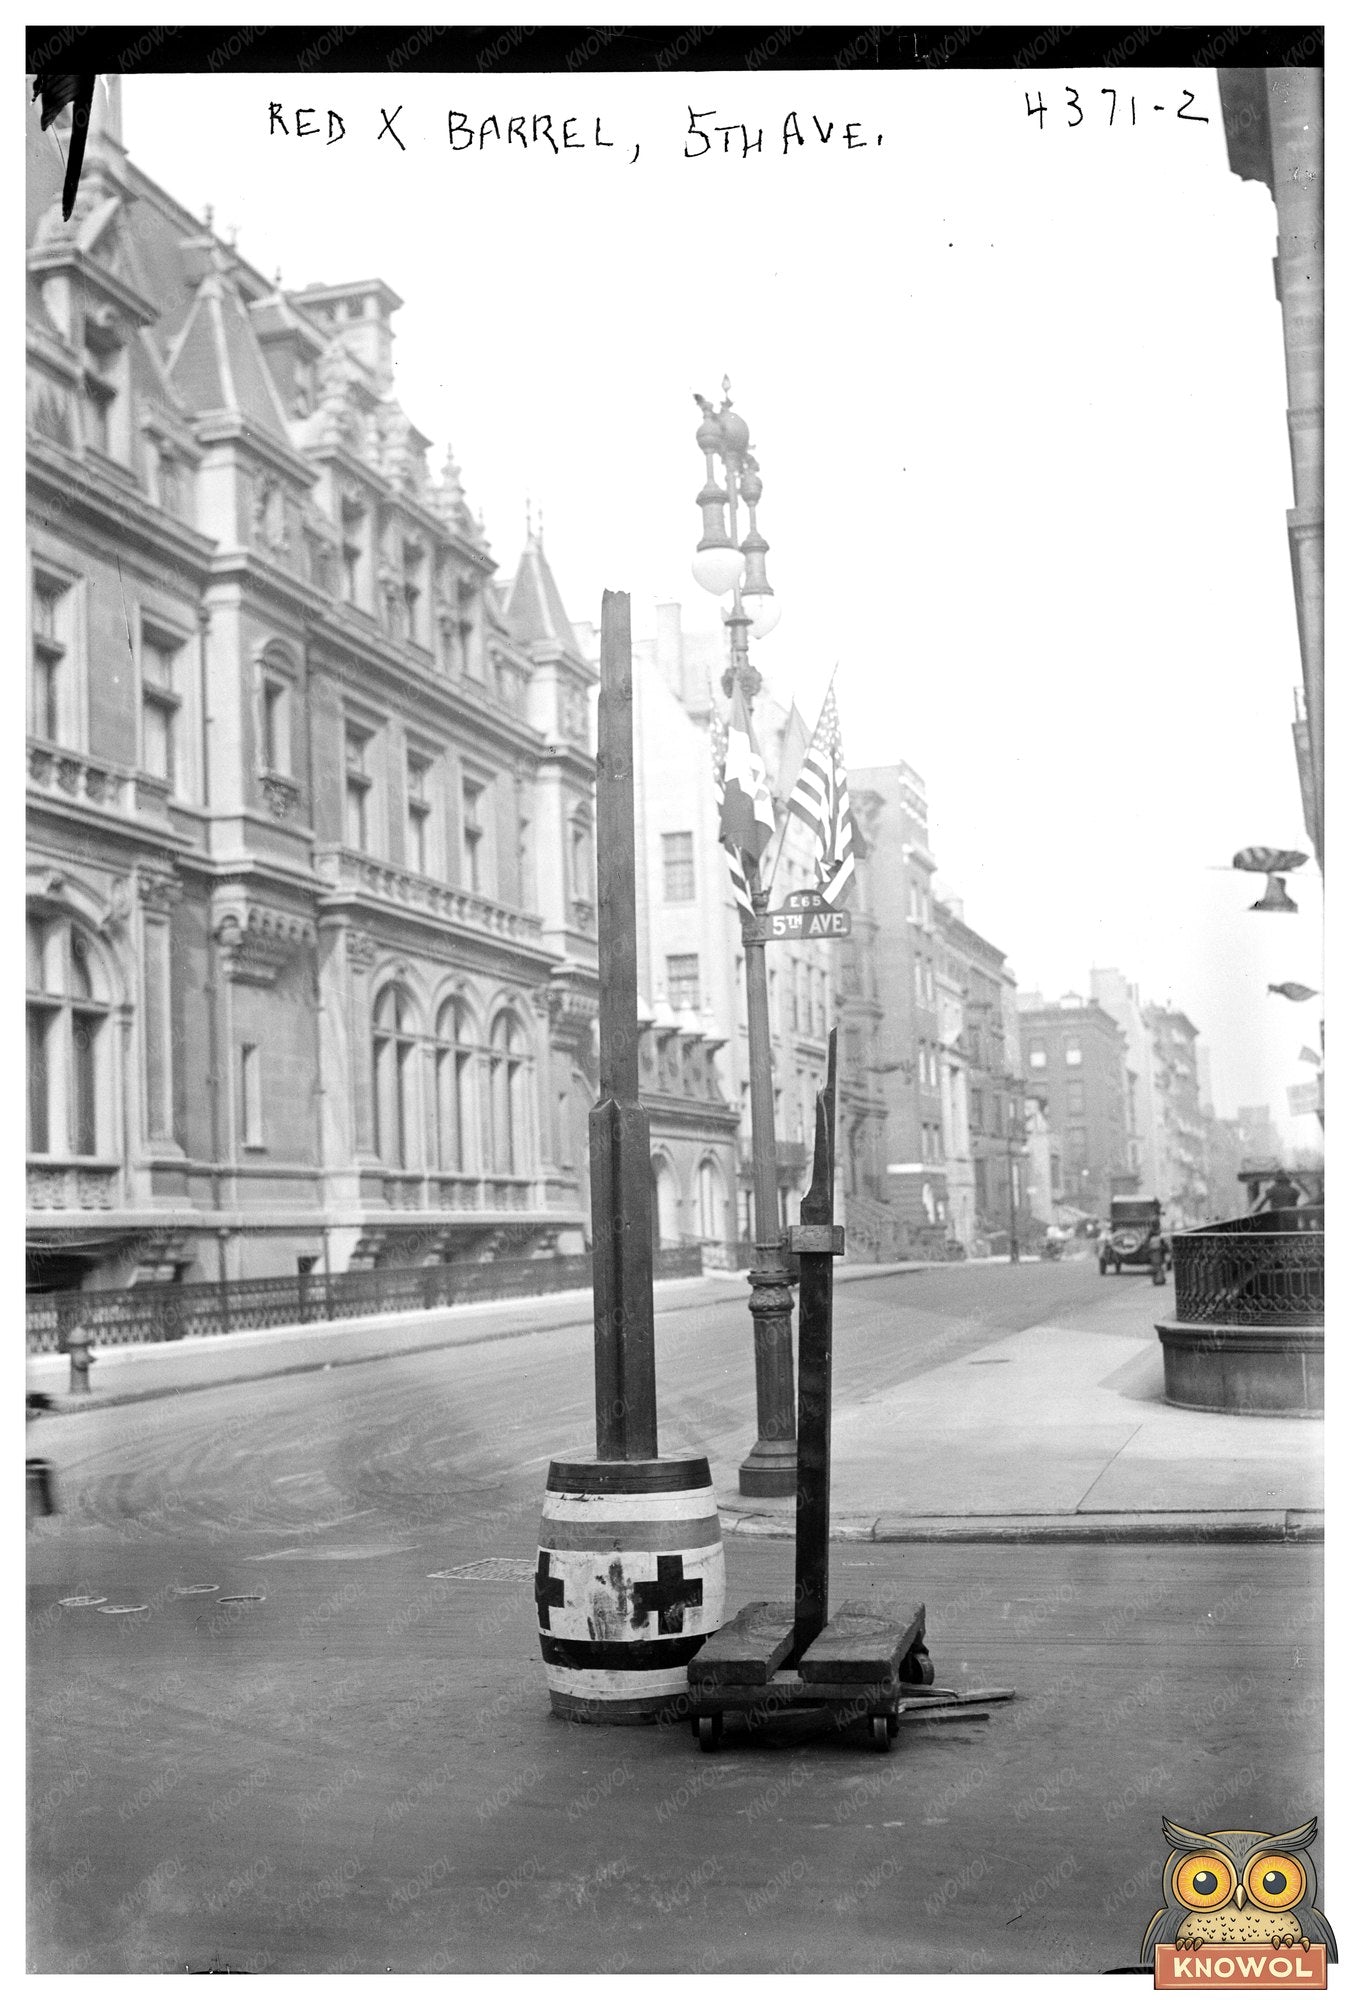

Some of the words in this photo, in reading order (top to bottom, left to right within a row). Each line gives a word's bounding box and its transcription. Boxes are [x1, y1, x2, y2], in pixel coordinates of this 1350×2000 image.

[1025, 86, 1209, 130] 4371-2
[268, 101, 346, 146] RED
[377, 105, 406, 151] X
[448, 110, 640, 164] BARREL,
[684, 105, 763, 159] 5TH
[782, 111, 883, 155] AVE.
[773, 914, 803, 935] 5TH
